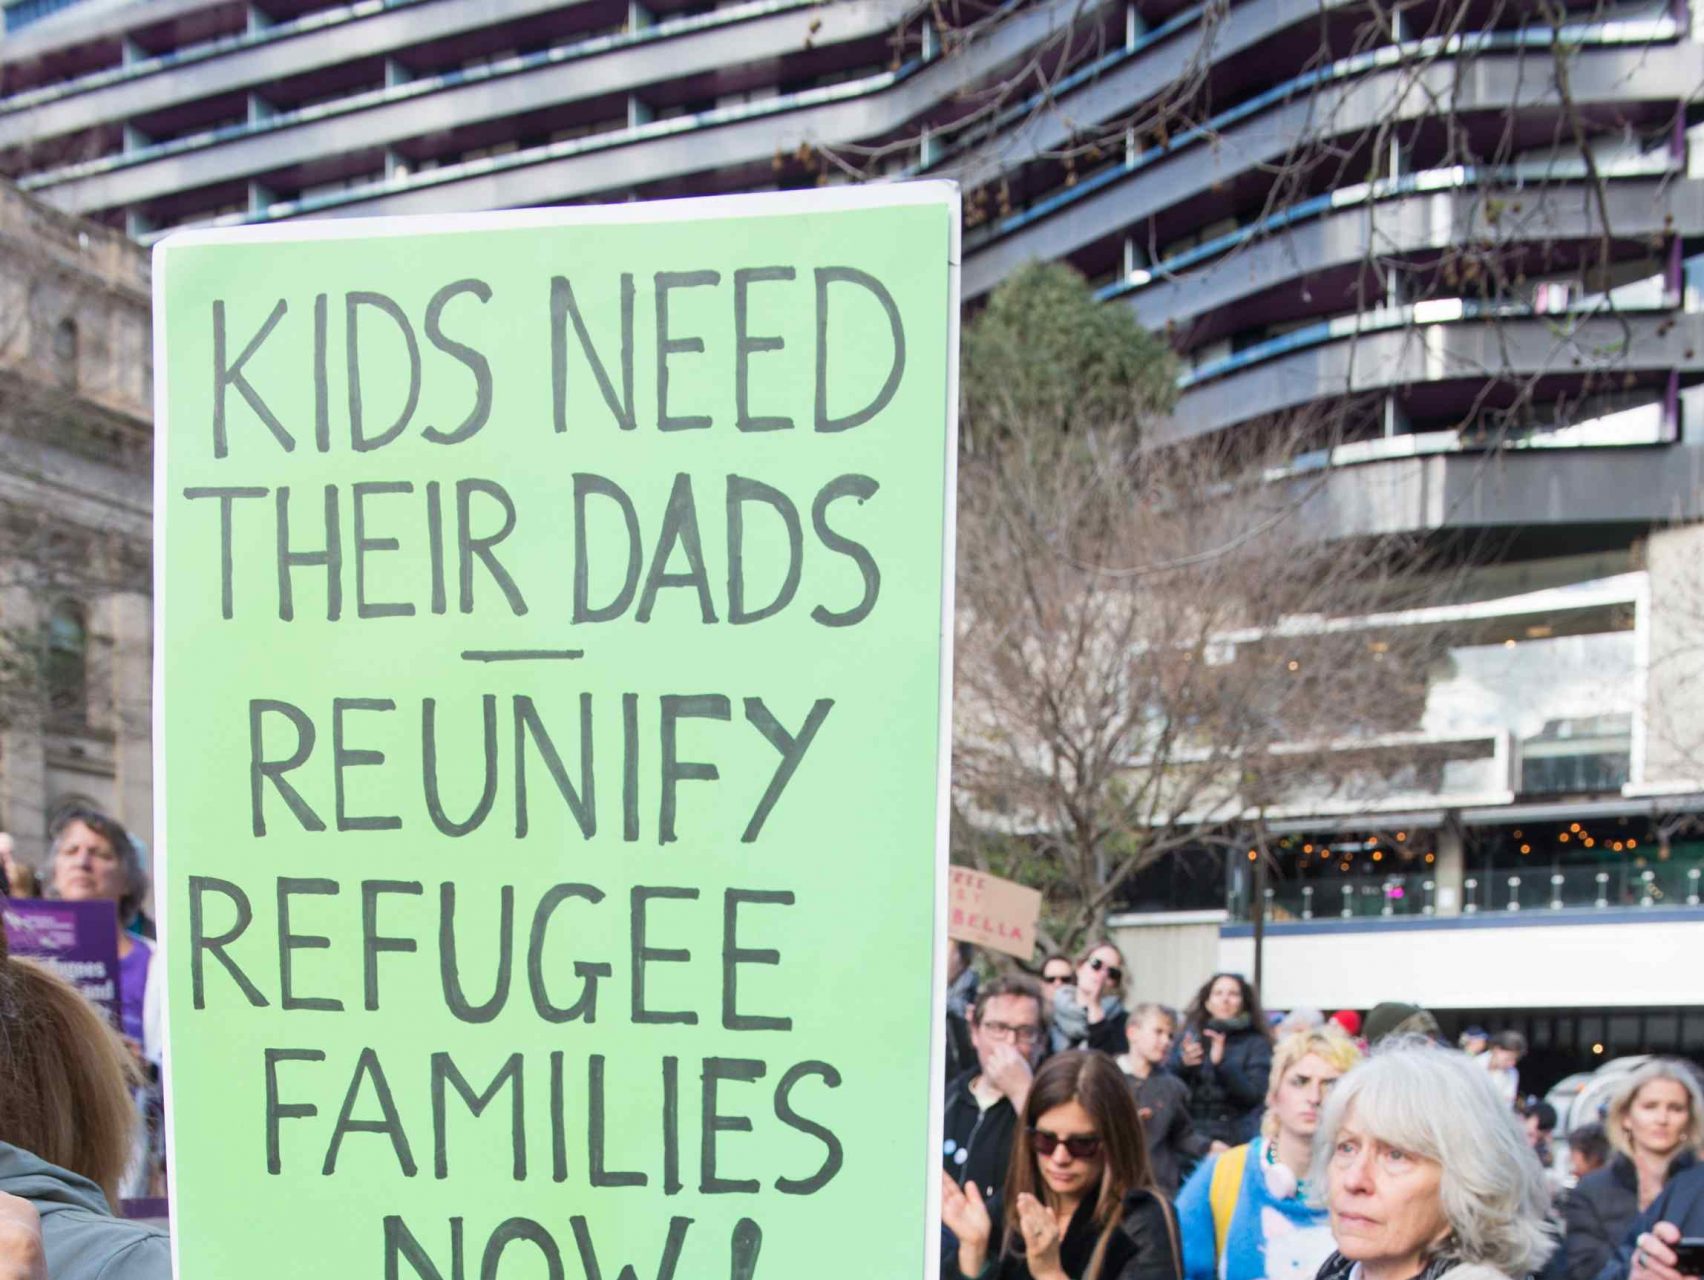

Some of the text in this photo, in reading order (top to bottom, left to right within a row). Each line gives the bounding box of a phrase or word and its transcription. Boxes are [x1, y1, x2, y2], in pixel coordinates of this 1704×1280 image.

[212, 266, 907, 460] KIDS NEED
[183, 471, 882, 628] THEIR DADS
[249, 692, 836, 846] REUNIFY
[188, 875, 796, 1032] REFUGEE
[953, 908, 1022, 938] BELLA
[264, 1046, 844, 1197] FAMILIES
